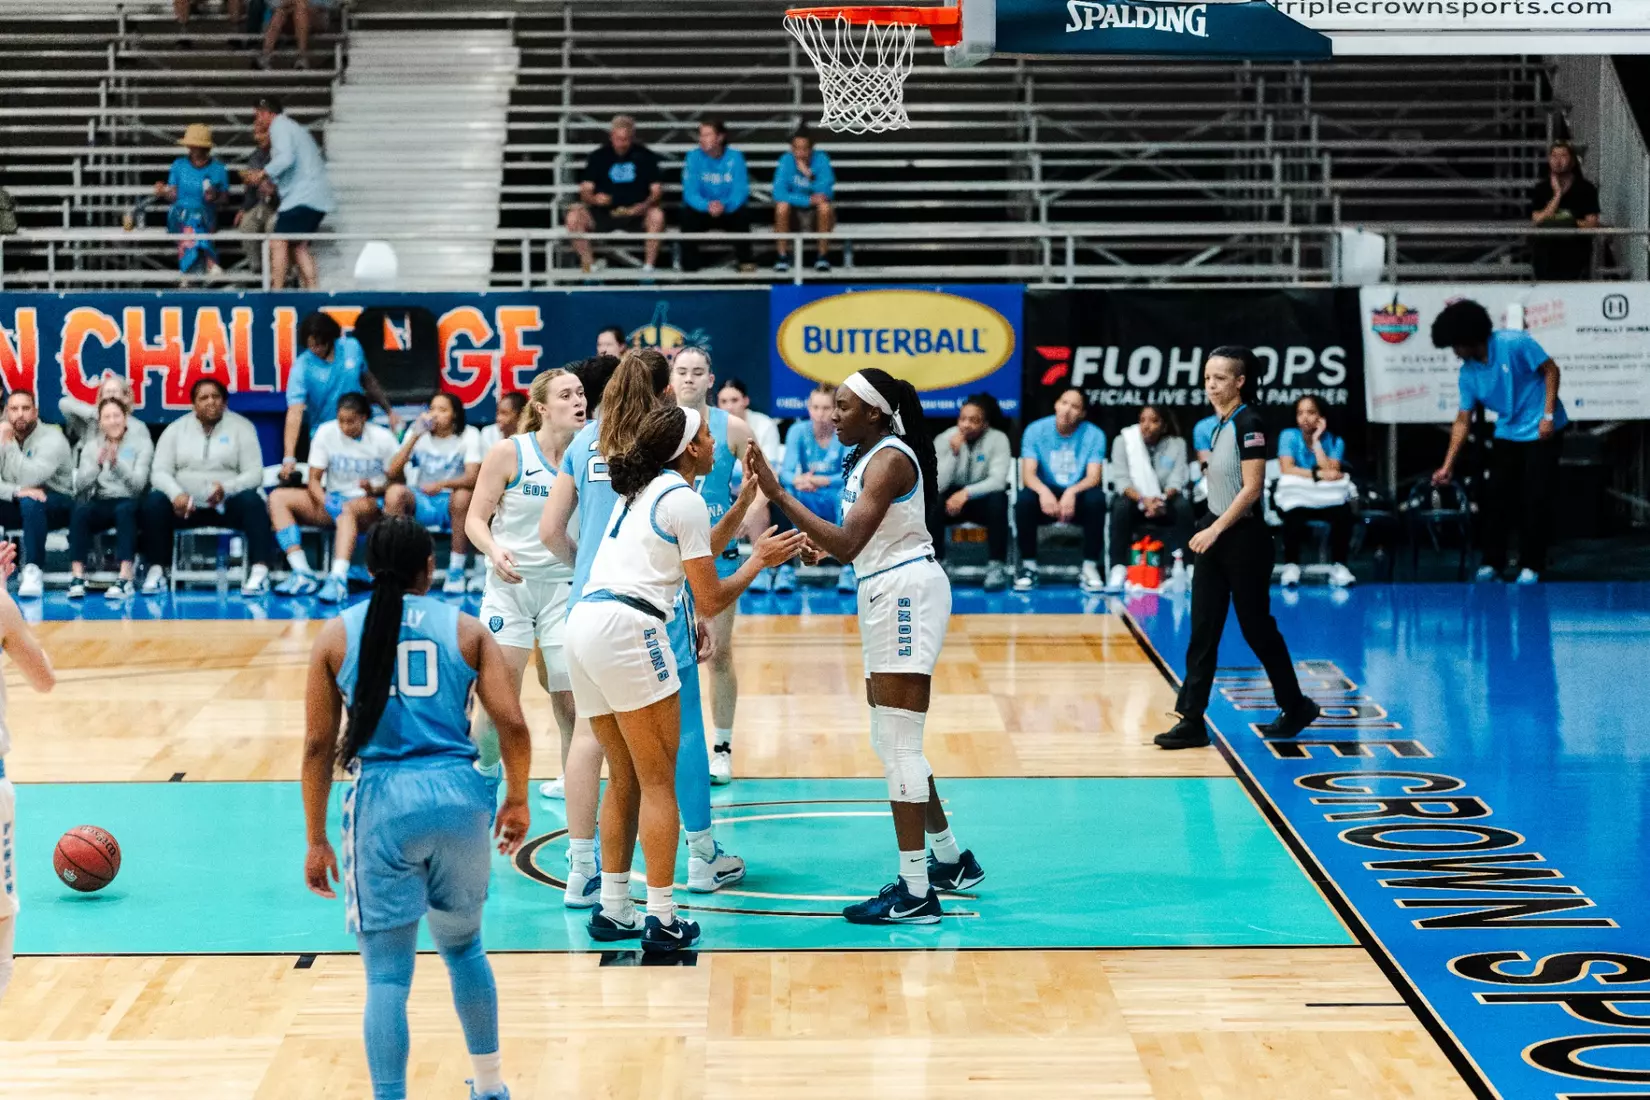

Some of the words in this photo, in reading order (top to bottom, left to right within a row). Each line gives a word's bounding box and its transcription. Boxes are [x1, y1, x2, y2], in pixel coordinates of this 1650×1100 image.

[1065, 0, 1209, 37] SPALDING
[56, 306, 544, 410] CHALLGE
[803, 325, 986, 356] BUTTERBALL
[1071, 346, 1347, 387] FLOHOPS
[643, 627, 669, 682] LIONS
[897, 597, 911, 657] LIONS
[1293, 770, 1621, 931] CROWN
[1445, 950, 1650, 1100] SPO
